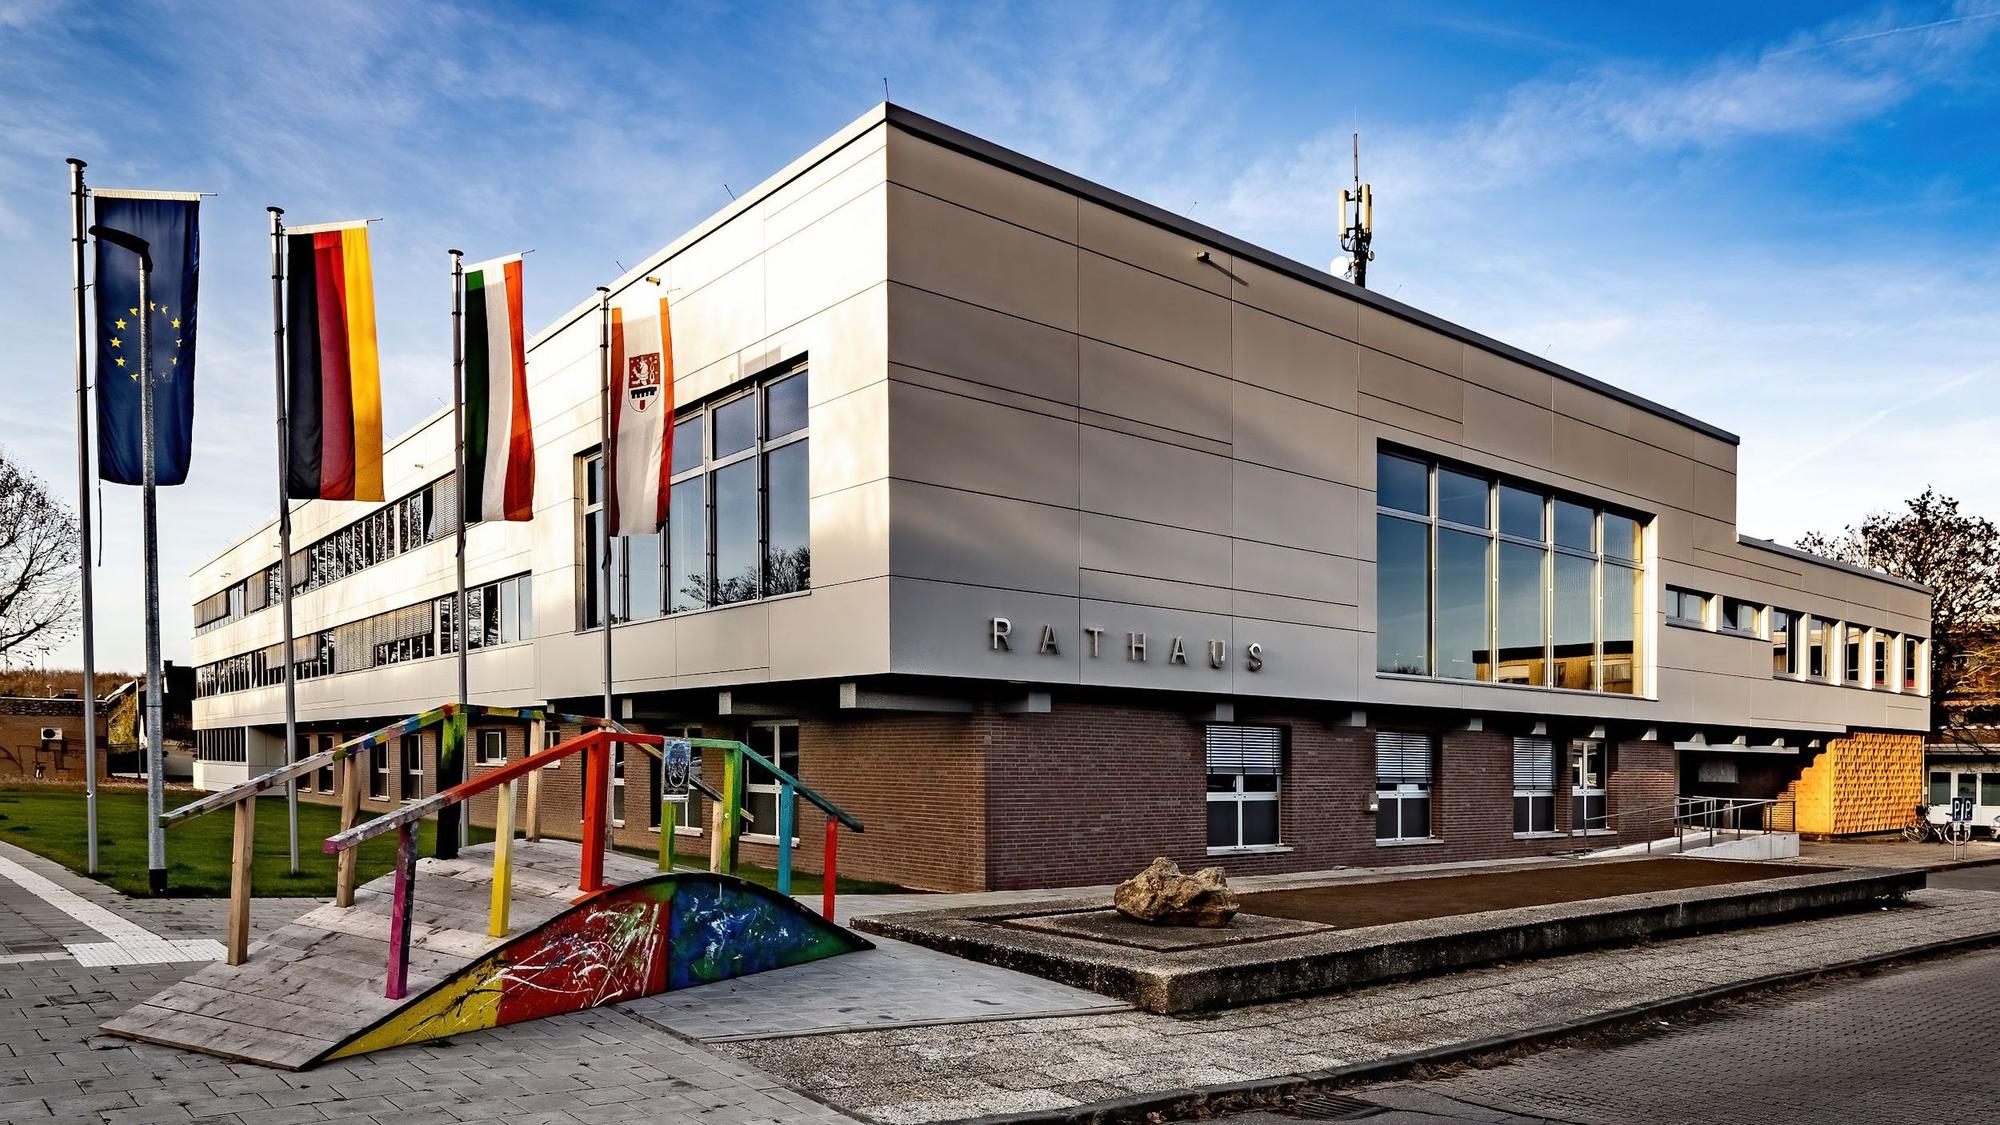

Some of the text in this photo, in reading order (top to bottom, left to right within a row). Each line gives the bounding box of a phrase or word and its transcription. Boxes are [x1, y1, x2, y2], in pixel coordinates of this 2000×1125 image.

[991, 616, 1263, 672] RATHAUS
[1954, 800, 1960, 819] P
[1965, 800, 1971, 819] P
